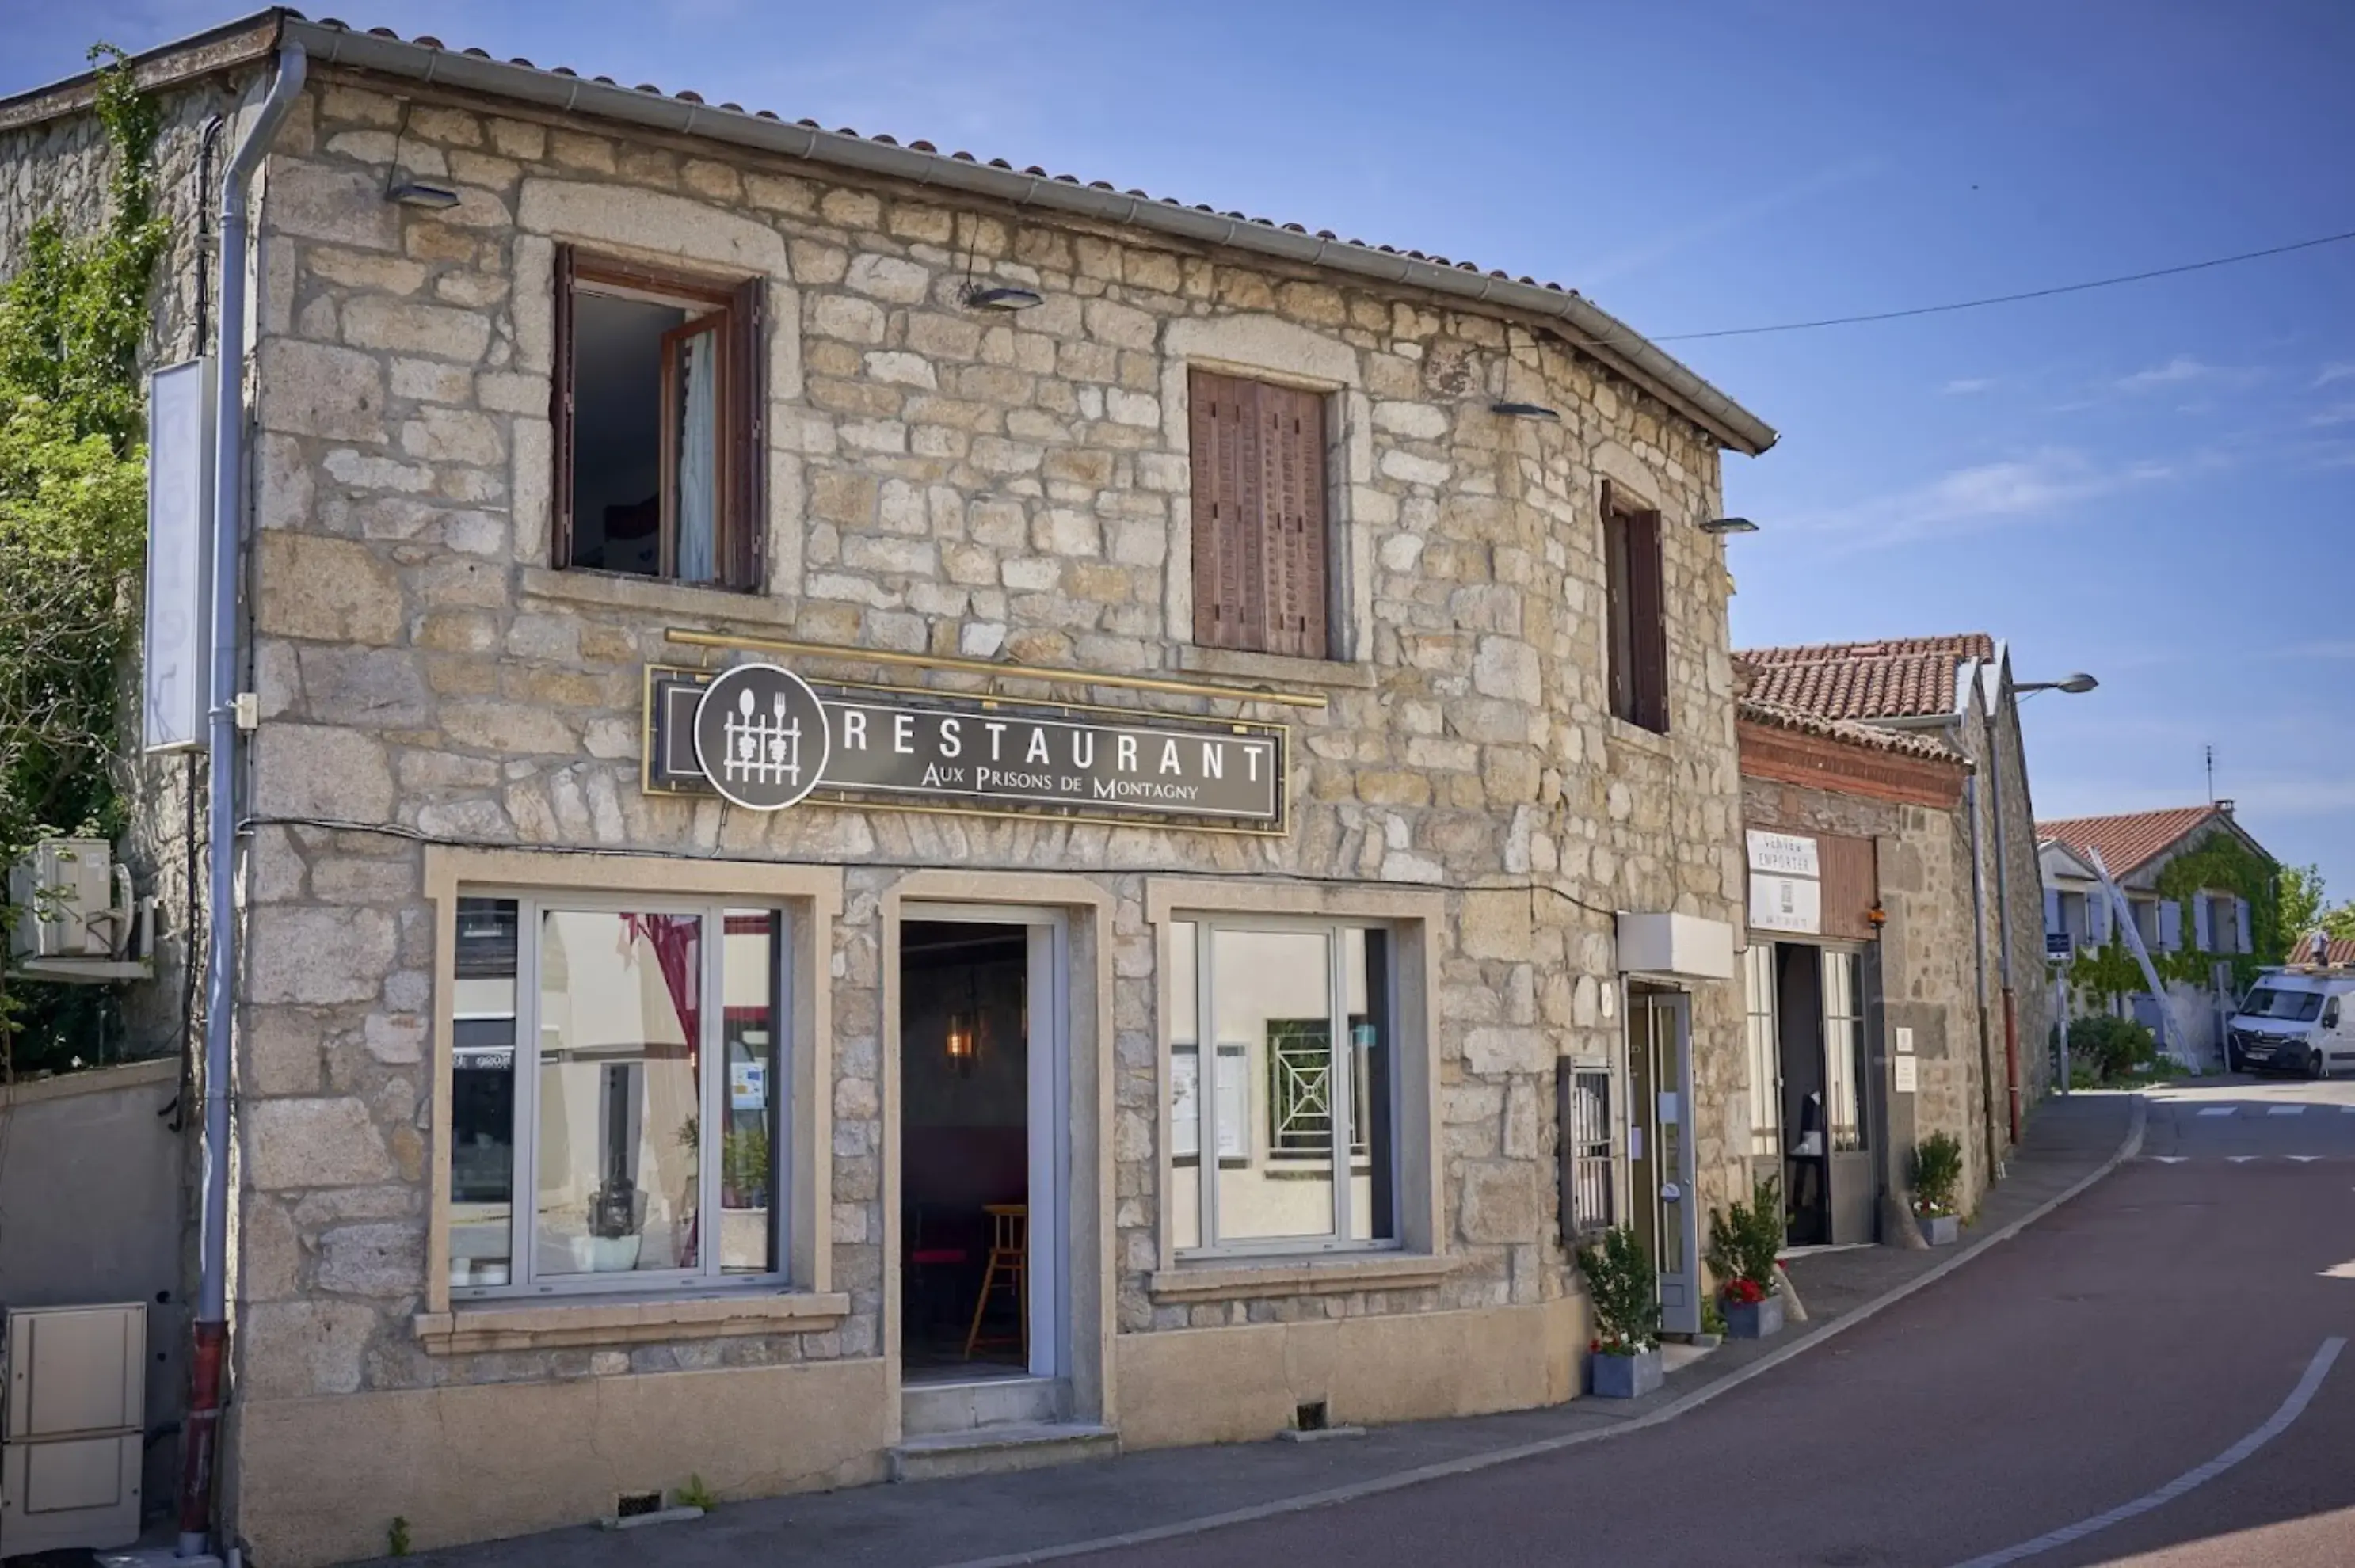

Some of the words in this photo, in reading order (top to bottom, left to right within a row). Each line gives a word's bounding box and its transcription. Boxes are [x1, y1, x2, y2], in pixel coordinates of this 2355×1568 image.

[844, 710, 1263, 782] RESTAURANT
[920, 761, 966, 787] AUX
[976, 766, 1053, 790] PRISONS
[1061, 776, 1083, 792] DE
[1092, 776, 1199, 800] MONTAGNY
